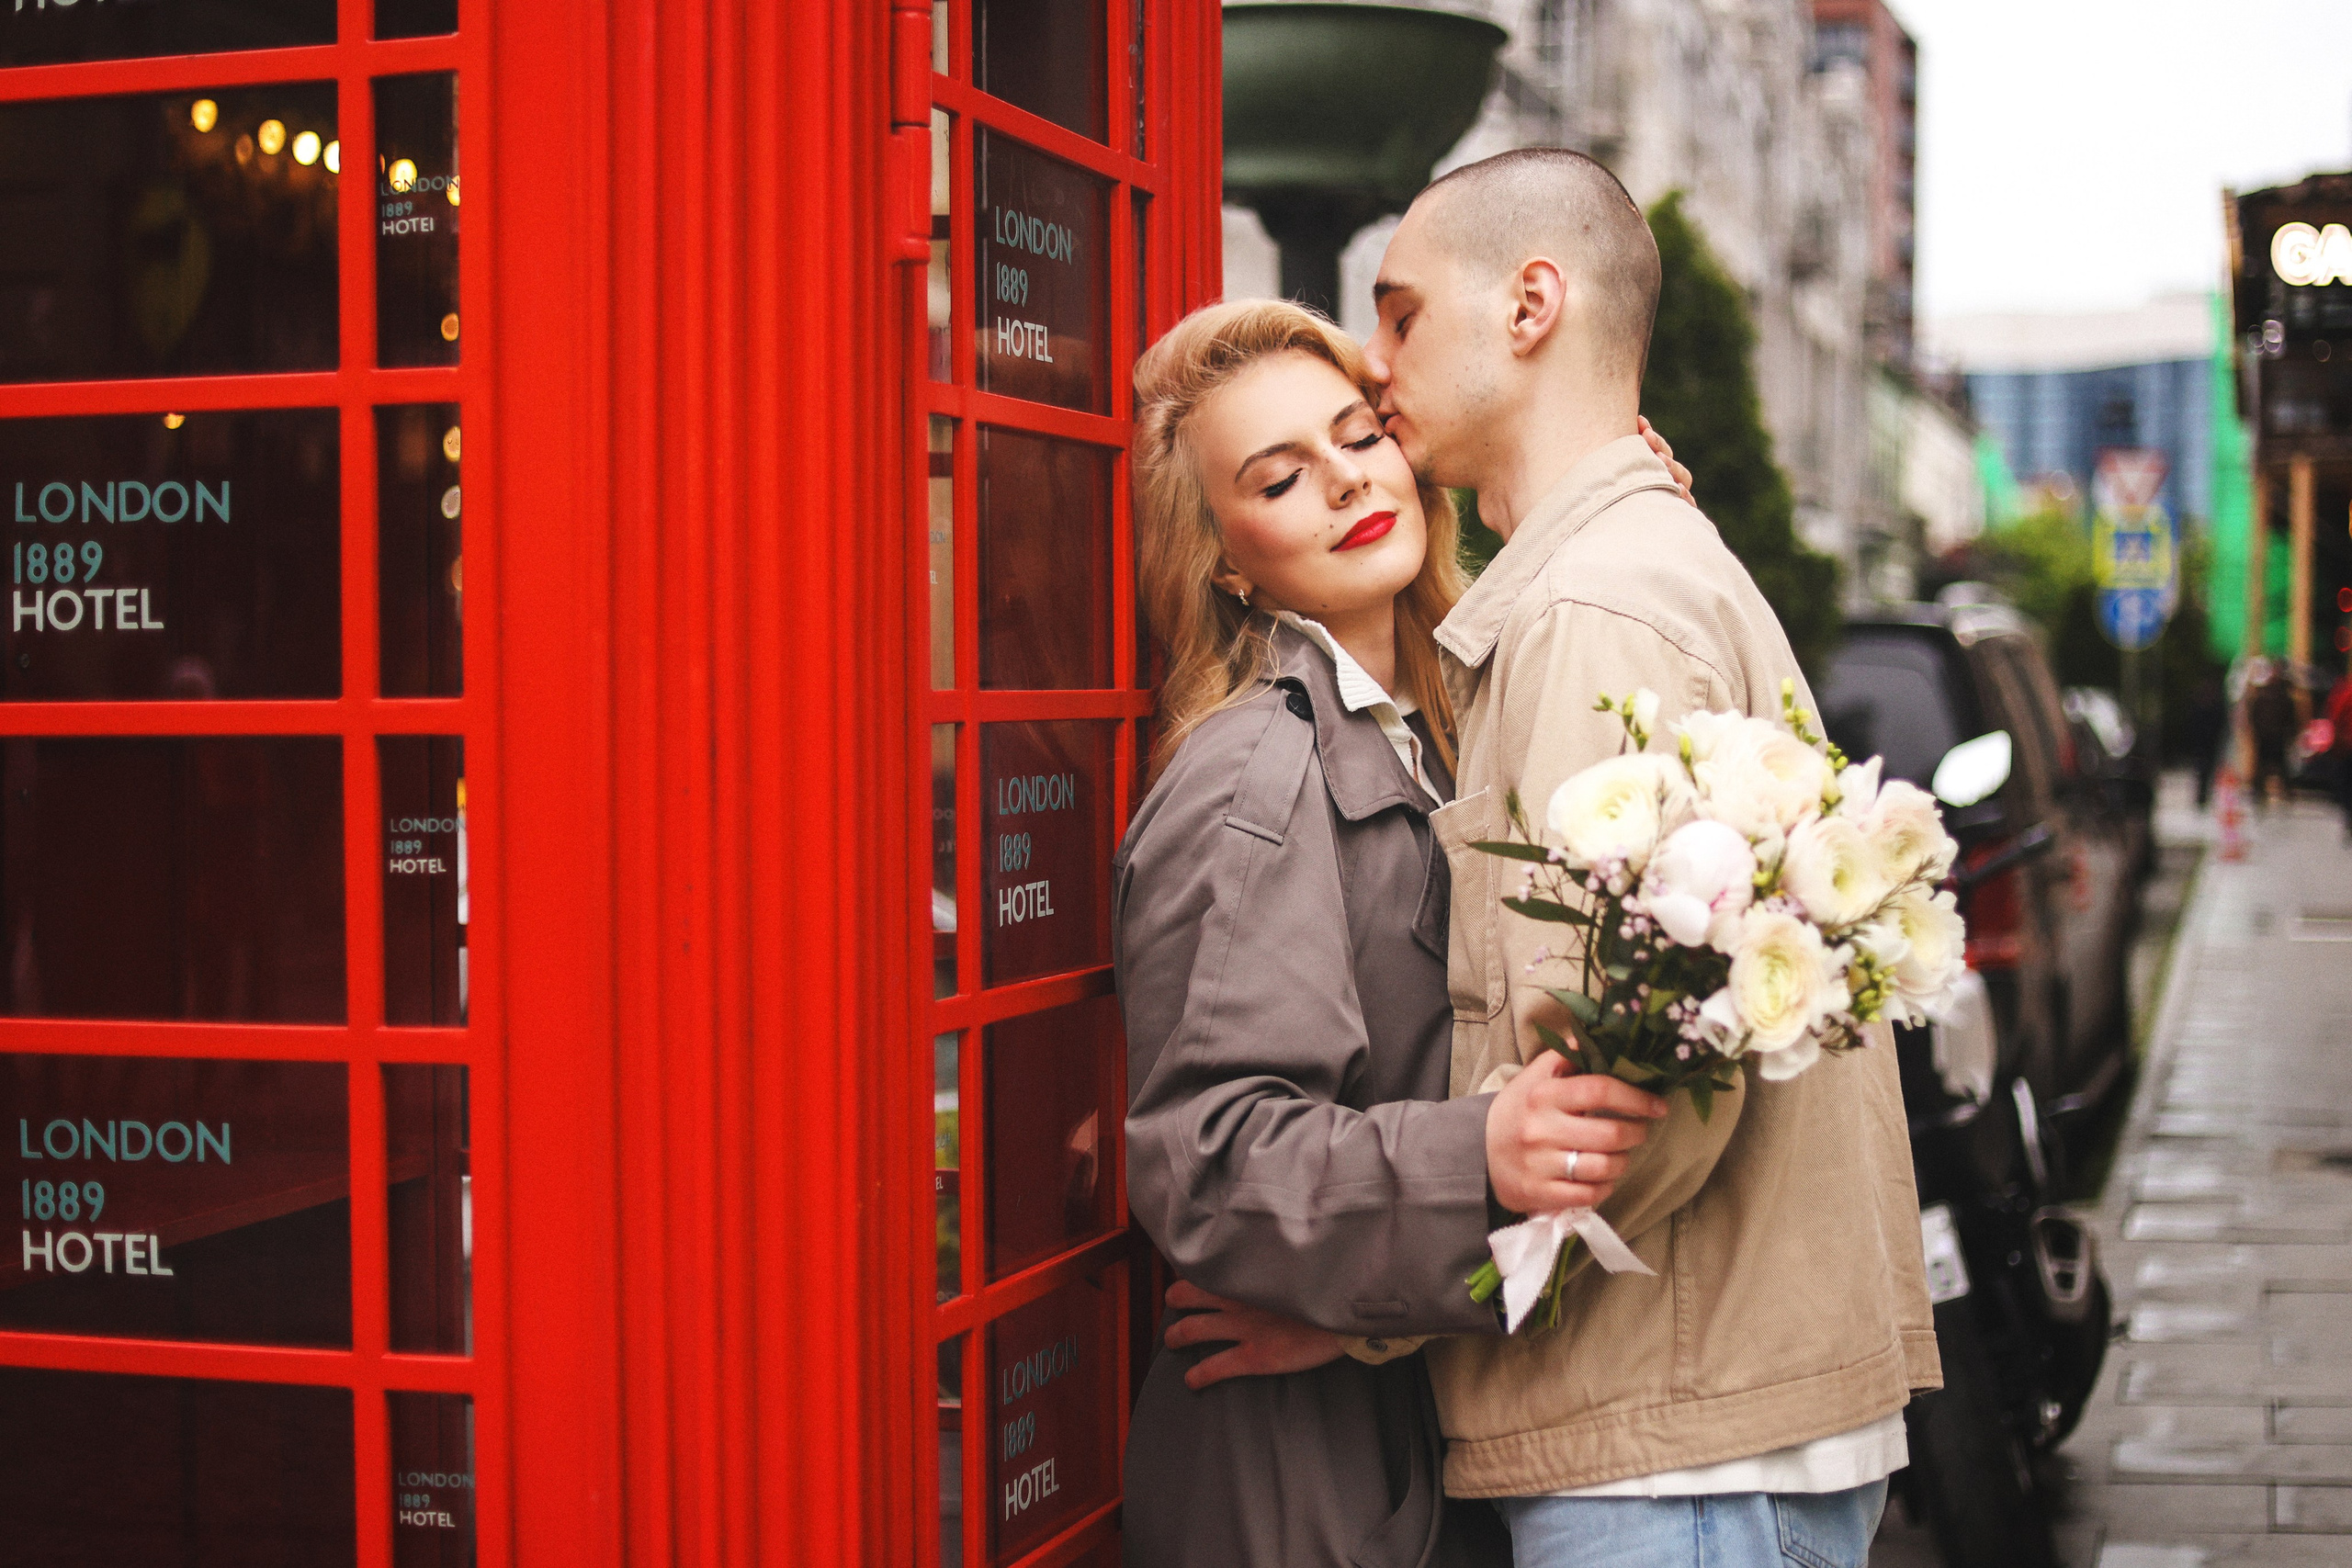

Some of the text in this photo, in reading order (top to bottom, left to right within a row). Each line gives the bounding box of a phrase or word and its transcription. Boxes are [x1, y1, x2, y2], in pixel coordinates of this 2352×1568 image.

[382, 200, 413, 217] 1889
[995, 206, 1072, 265] LONDON
[996, 261, 1028, 308] 1889
[997, 316, 1054, 364] HOTEL
[15, 479, 230, 524] LONDON
[14, 540, 103, 584] 1889
[13, 588, 164, 632] HOTEL
[999, 773, 1075, 816] LONDON
[390, 840, 423, 855] 1889
[390, 858, 447, 874] HOTEL
[1000, 831, 1031, 873] 1889
[999, 879, 1055, 928] HOTEL
[19, 1118, 231, 1165] LONDON
[22, 1179, 105, 1223] 1889
[22, 1230, 174, 1276] HOTEL
[1003, 1335, 1079, 1405] LONDON
[1004, 1410, 1035, 1461] 1889
[1005, 1457, 1060, 1522] HOTEL
[399, 1510, 456, 1528] HOTEL
